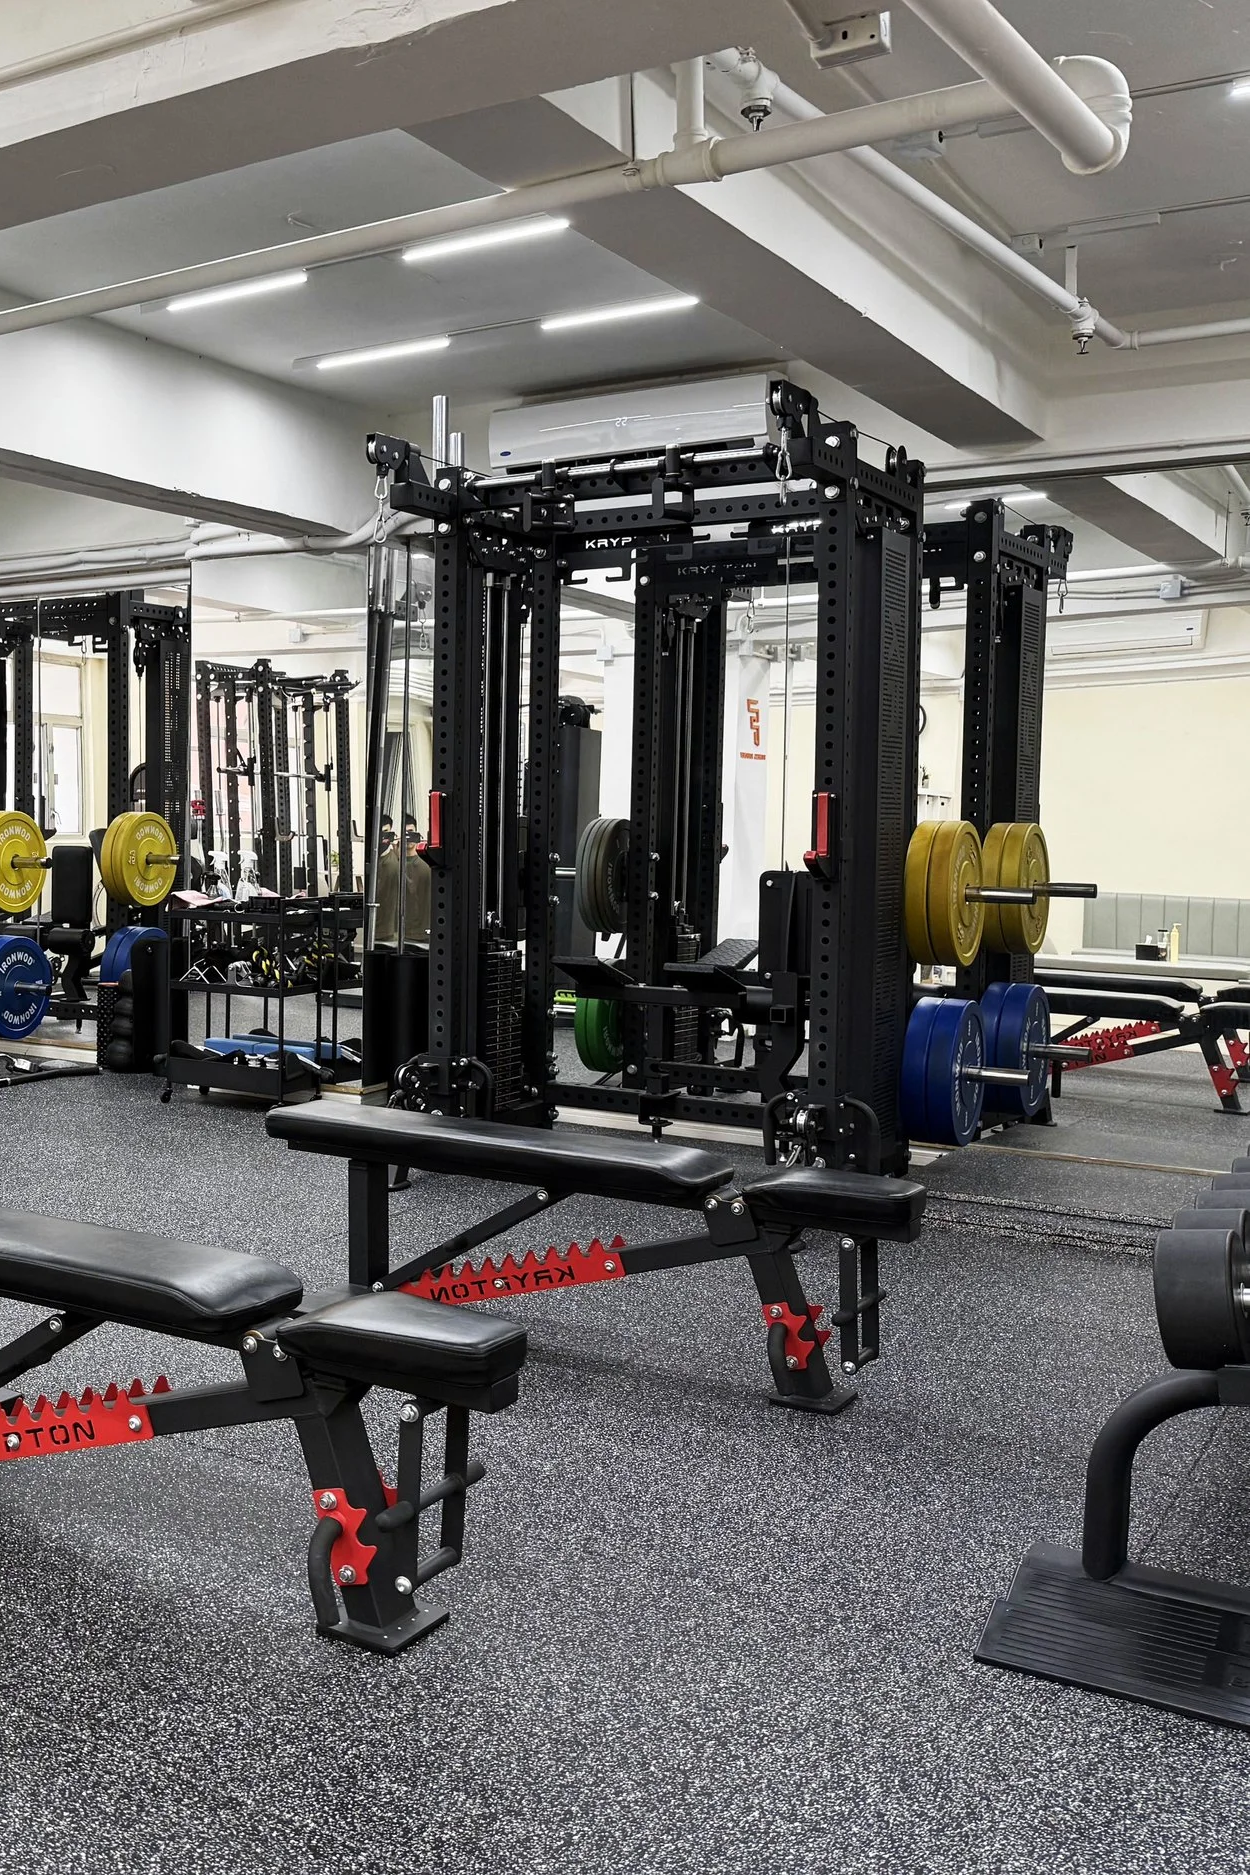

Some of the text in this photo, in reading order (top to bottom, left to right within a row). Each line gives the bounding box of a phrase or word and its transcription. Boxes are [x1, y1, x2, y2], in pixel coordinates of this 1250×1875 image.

[771, 520, 822, 534] KRYP
[0, 880, 33, 899] IRONWOD
[0, 951, 34, 974] IRONWOD
[3, 1003, 37, 1025] IRONWOD
